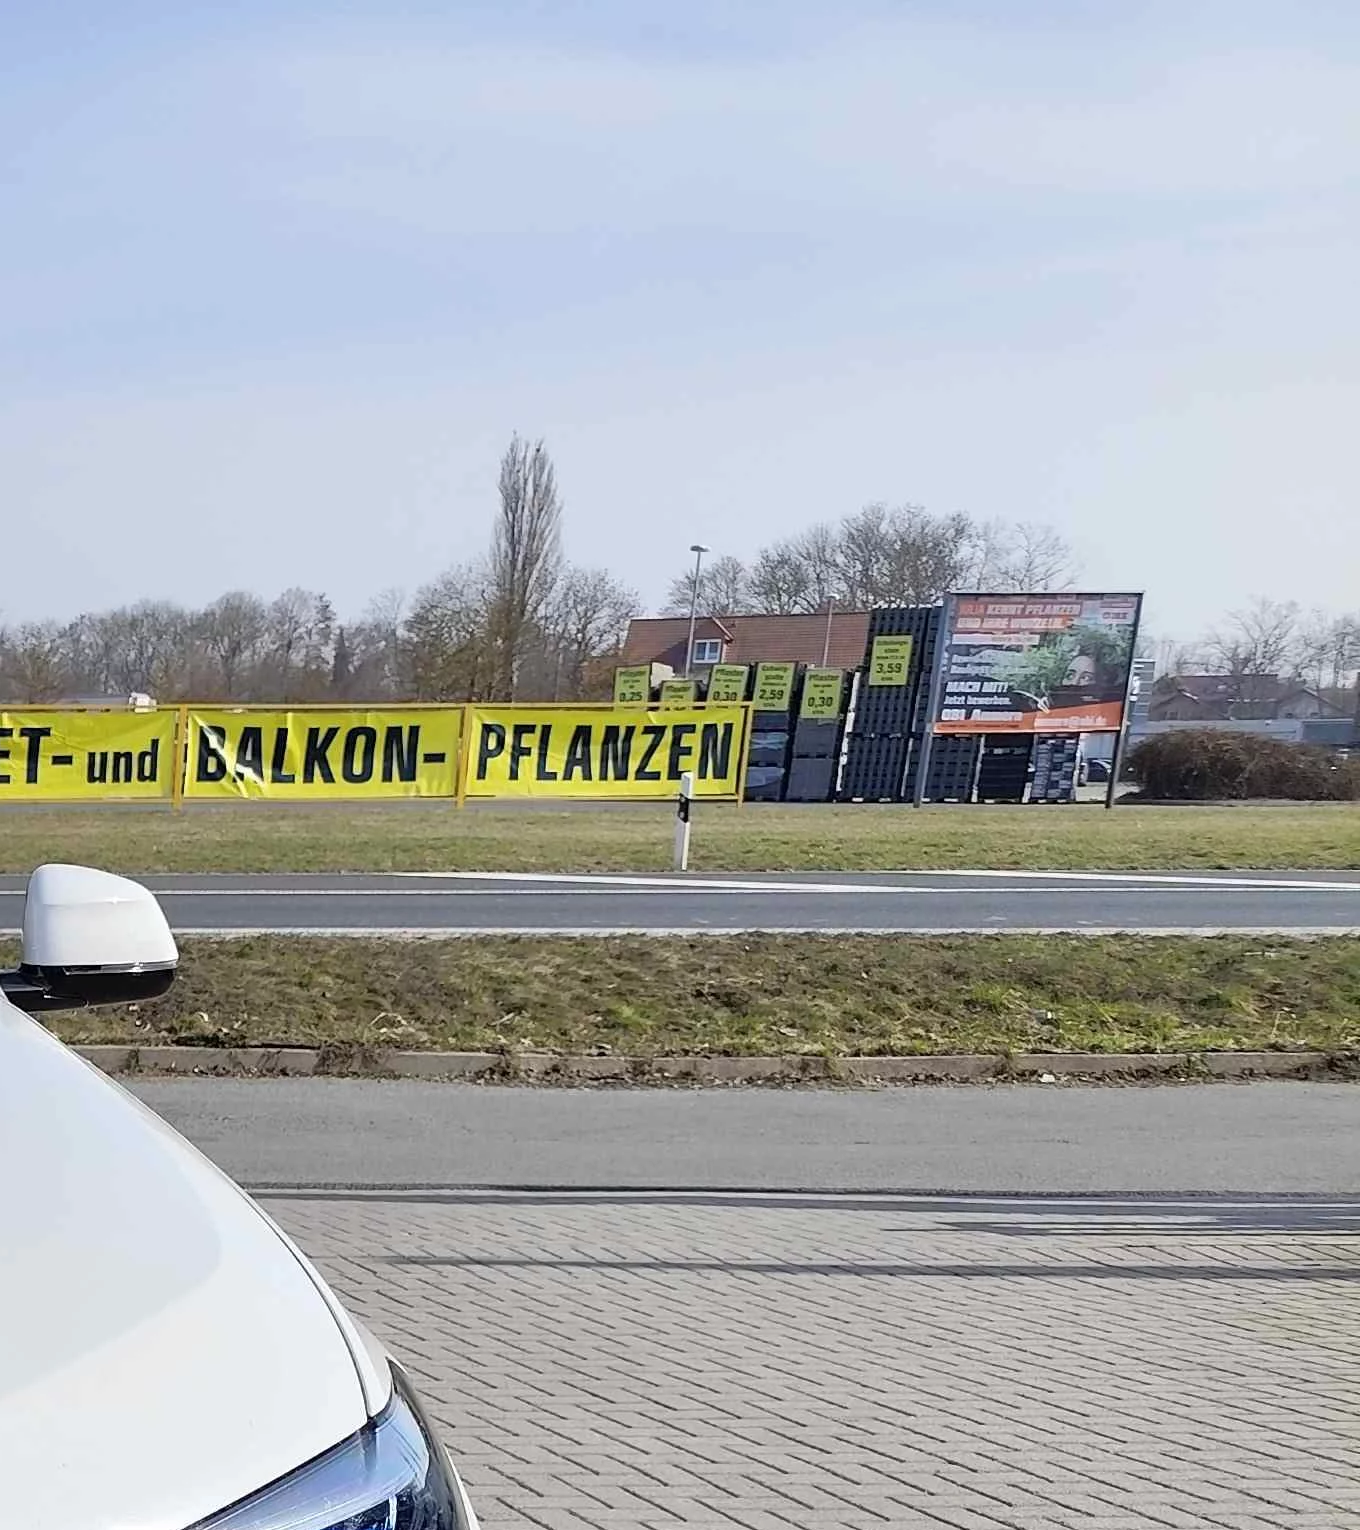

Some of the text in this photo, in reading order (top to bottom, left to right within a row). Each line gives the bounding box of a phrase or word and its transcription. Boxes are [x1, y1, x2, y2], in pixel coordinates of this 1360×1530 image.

[86, 738, 160, 784] und
[195, 724, 447, 784] BALKON-
[475, 722, 736, 782] PFLANZEN
